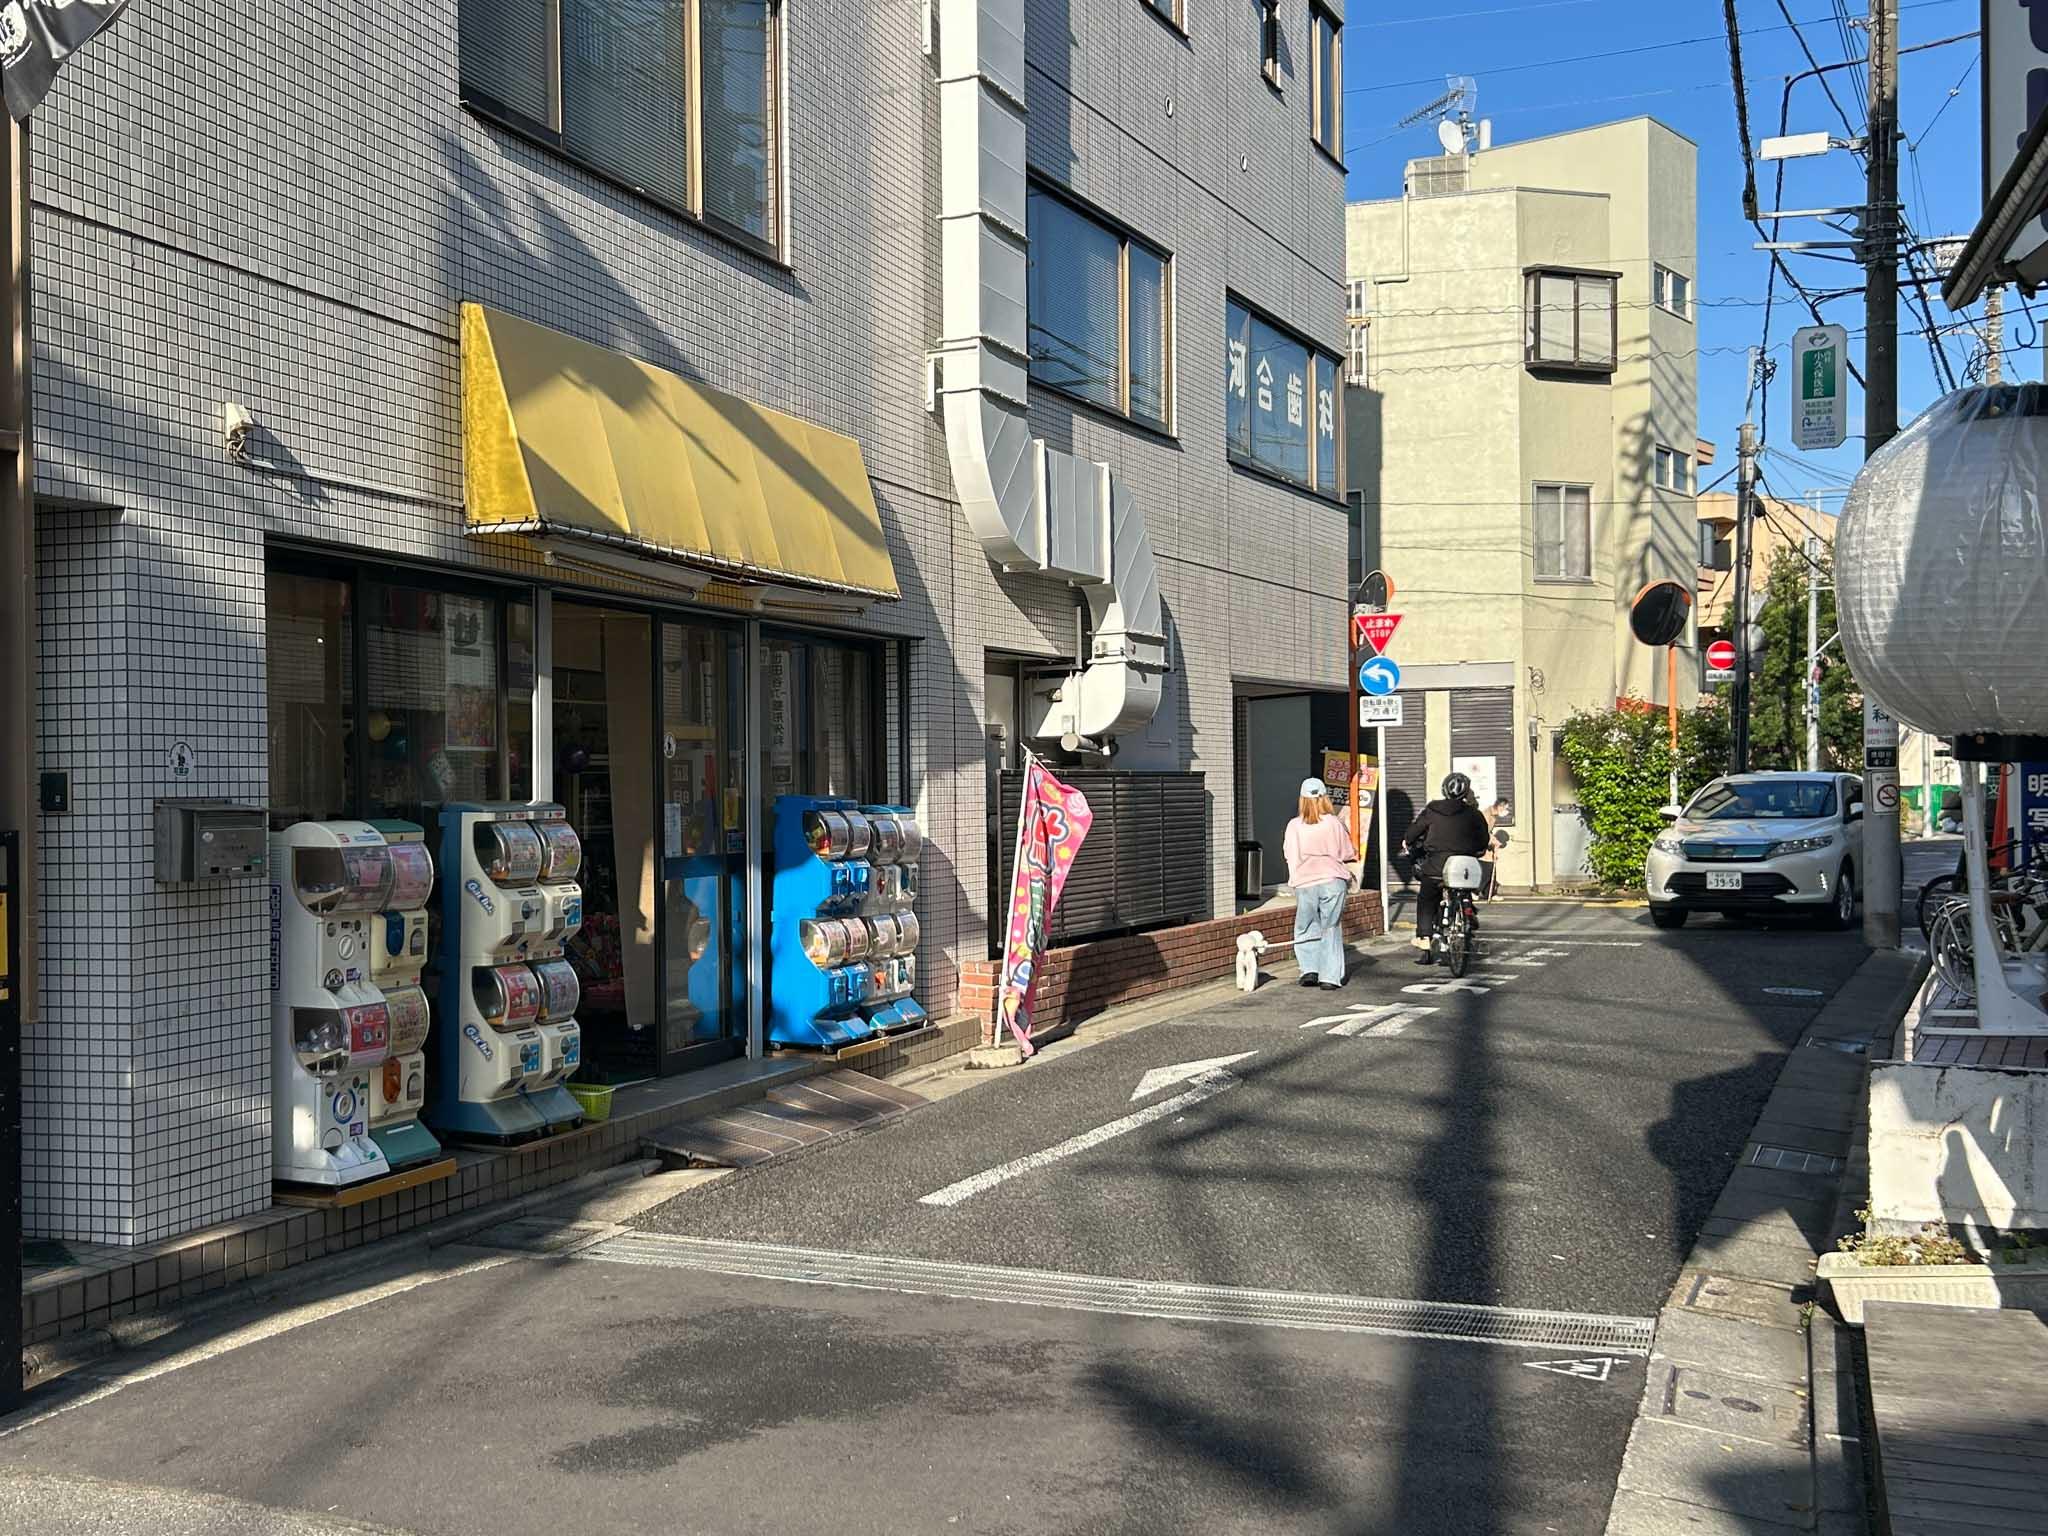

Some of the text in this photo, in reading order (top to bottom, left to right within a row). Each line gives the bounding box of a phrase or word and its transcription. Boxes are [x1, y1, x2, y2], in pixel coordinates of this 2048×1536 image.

[1229, 337, 1334, 439] 河合歯科
[1365, 618, 1395, 629] 止まれ
[1370, 629, 1391, 639] STOP
